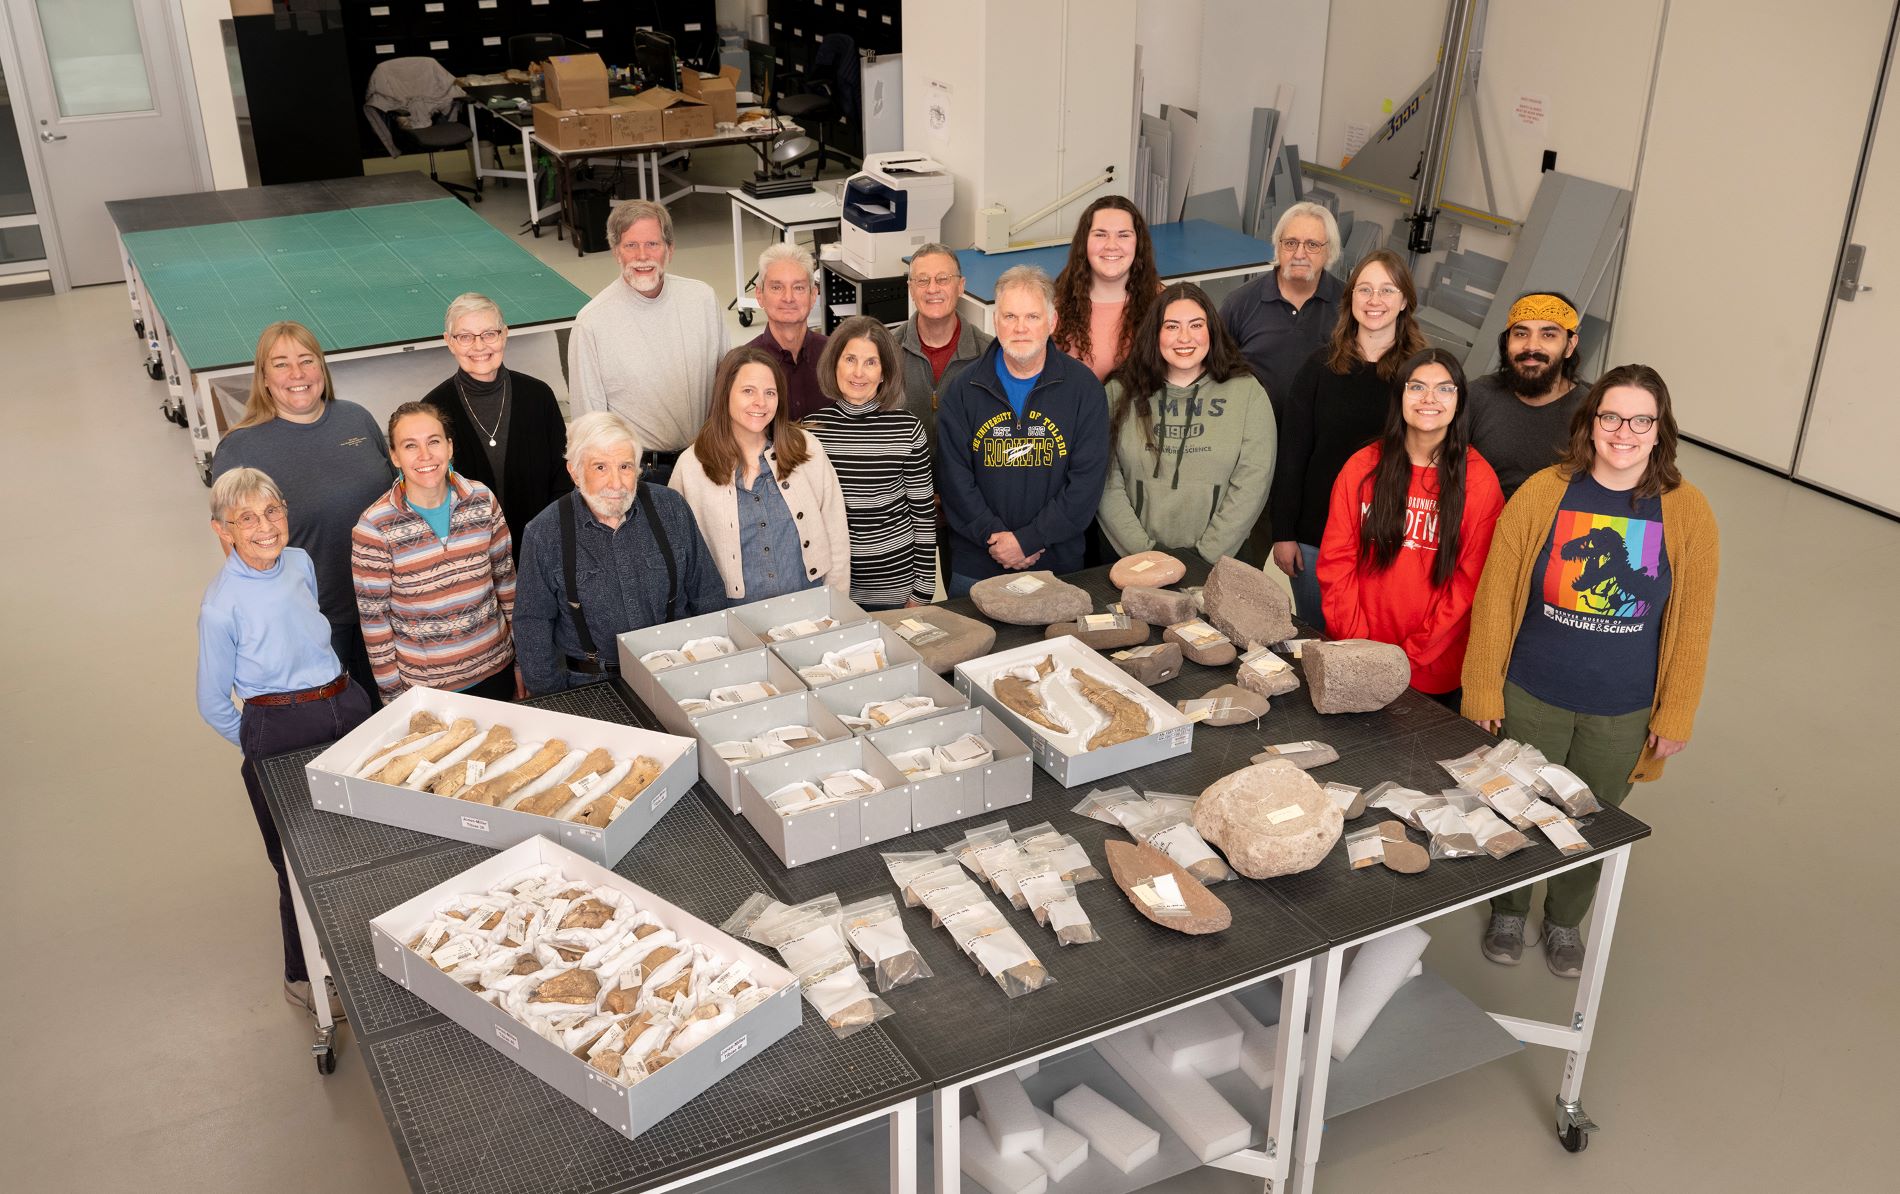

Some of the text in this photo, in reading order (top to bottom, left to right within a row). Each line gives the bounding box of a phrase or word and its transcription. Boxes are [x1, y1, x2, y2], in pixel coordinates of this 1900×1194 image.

[972, 410, 1068, 458] THE UNIVERSITY OF TOLEDO
[993, 426, 1012, 437] EST.
[984, 438, 1054, 467] ROCKETS
[1555, 609, 1579, 619] DENVER
[1582, 616, 1610, 624] MUSEUM
